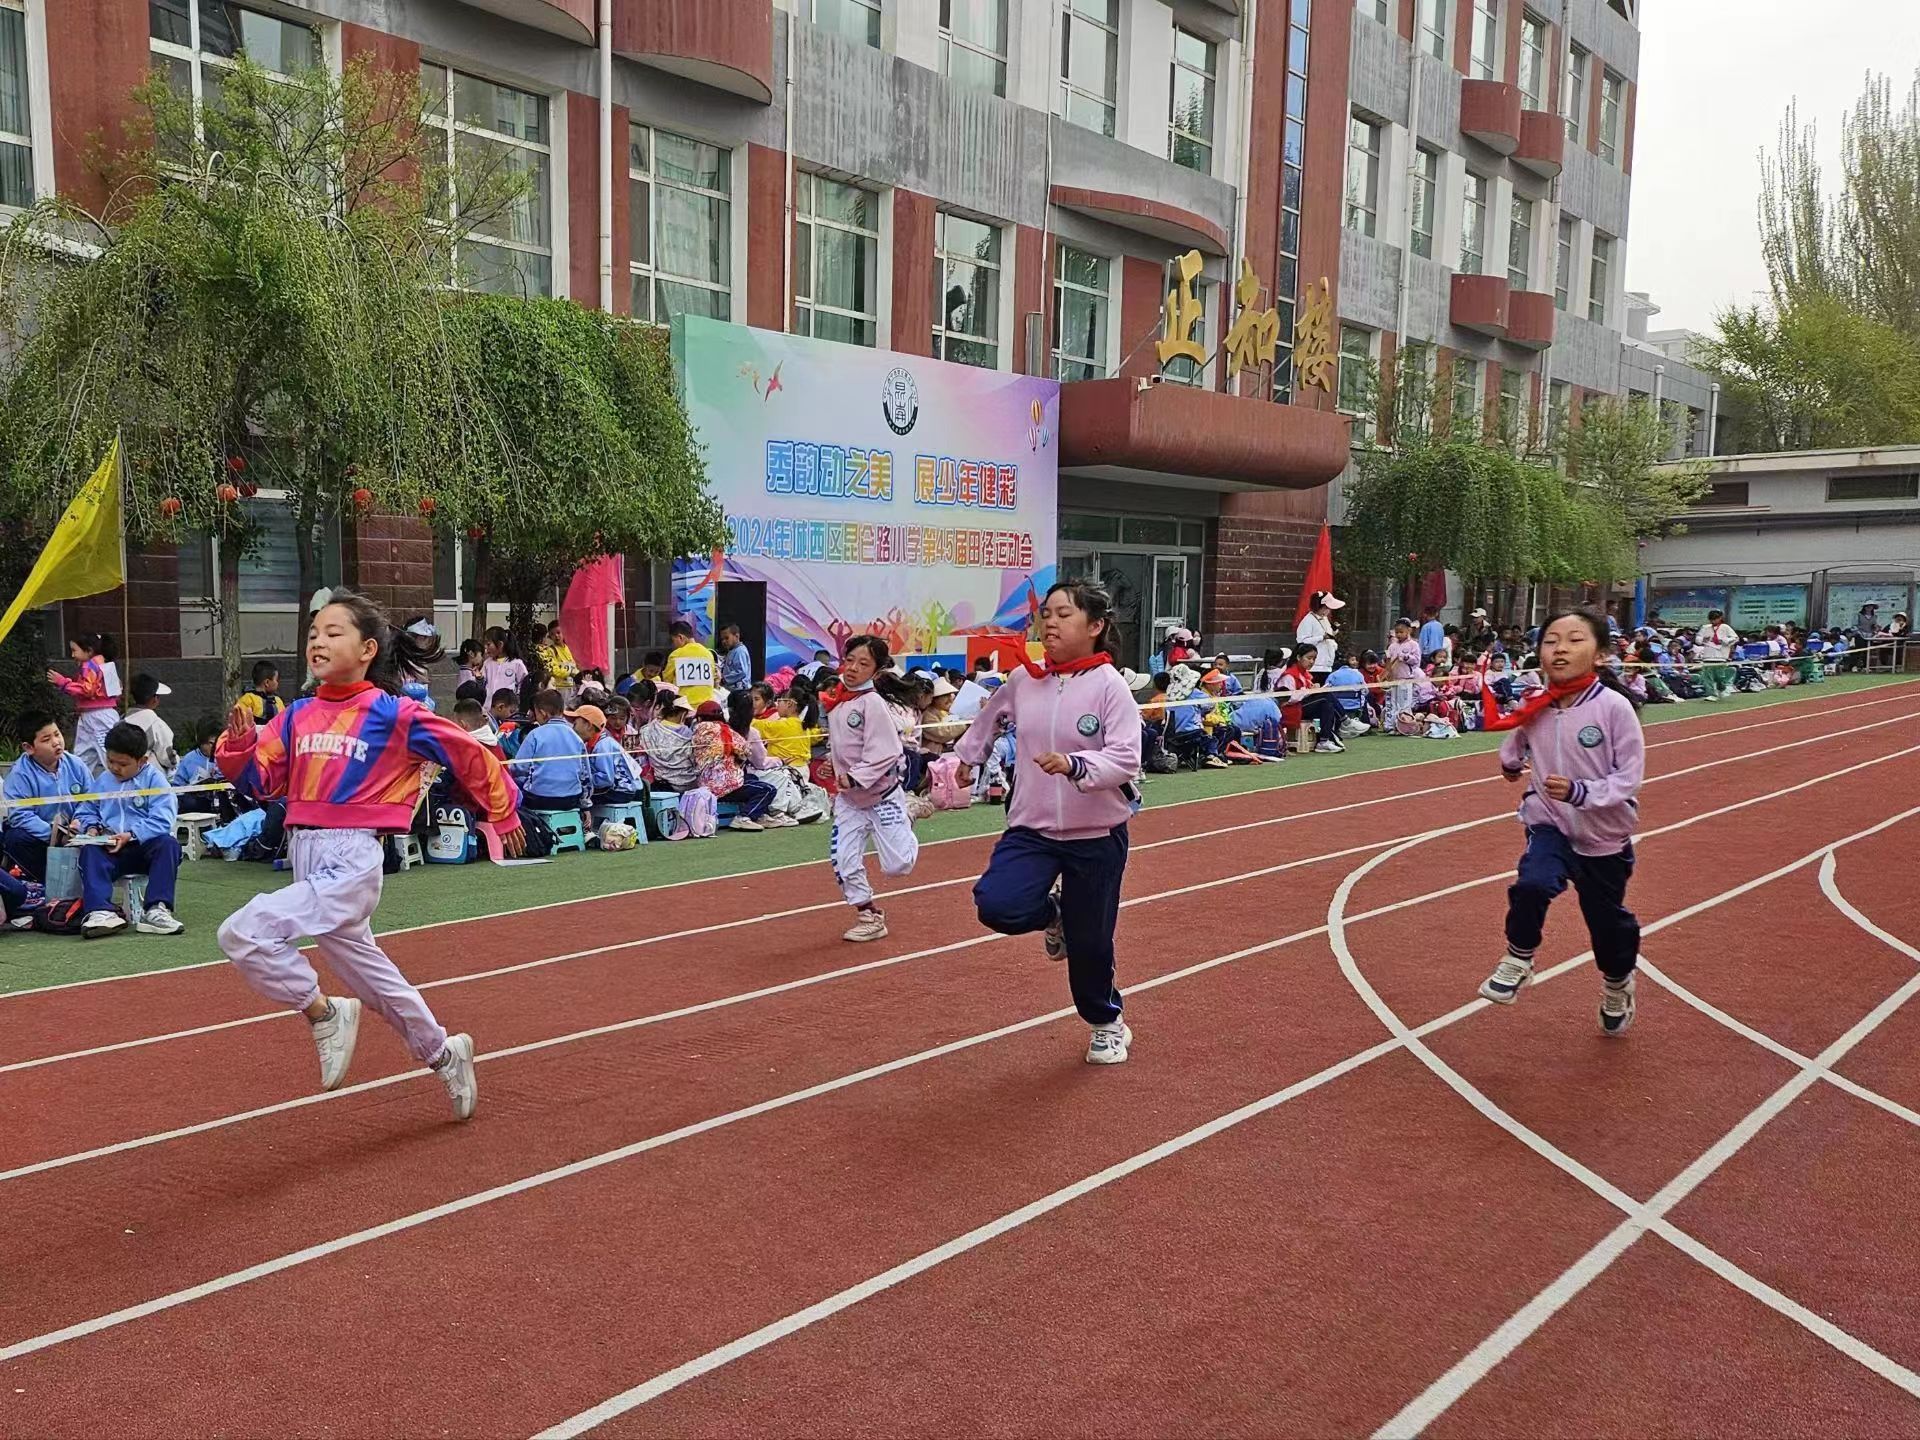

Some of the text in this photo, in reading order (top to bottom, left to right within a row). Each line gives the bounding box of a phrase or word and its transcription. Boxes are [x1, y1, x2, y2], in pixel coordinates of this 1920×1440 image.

[767, 441, 1017, 509] 秀韵动之美 展少年健彩
[679, 663, 711, 680] 1218
